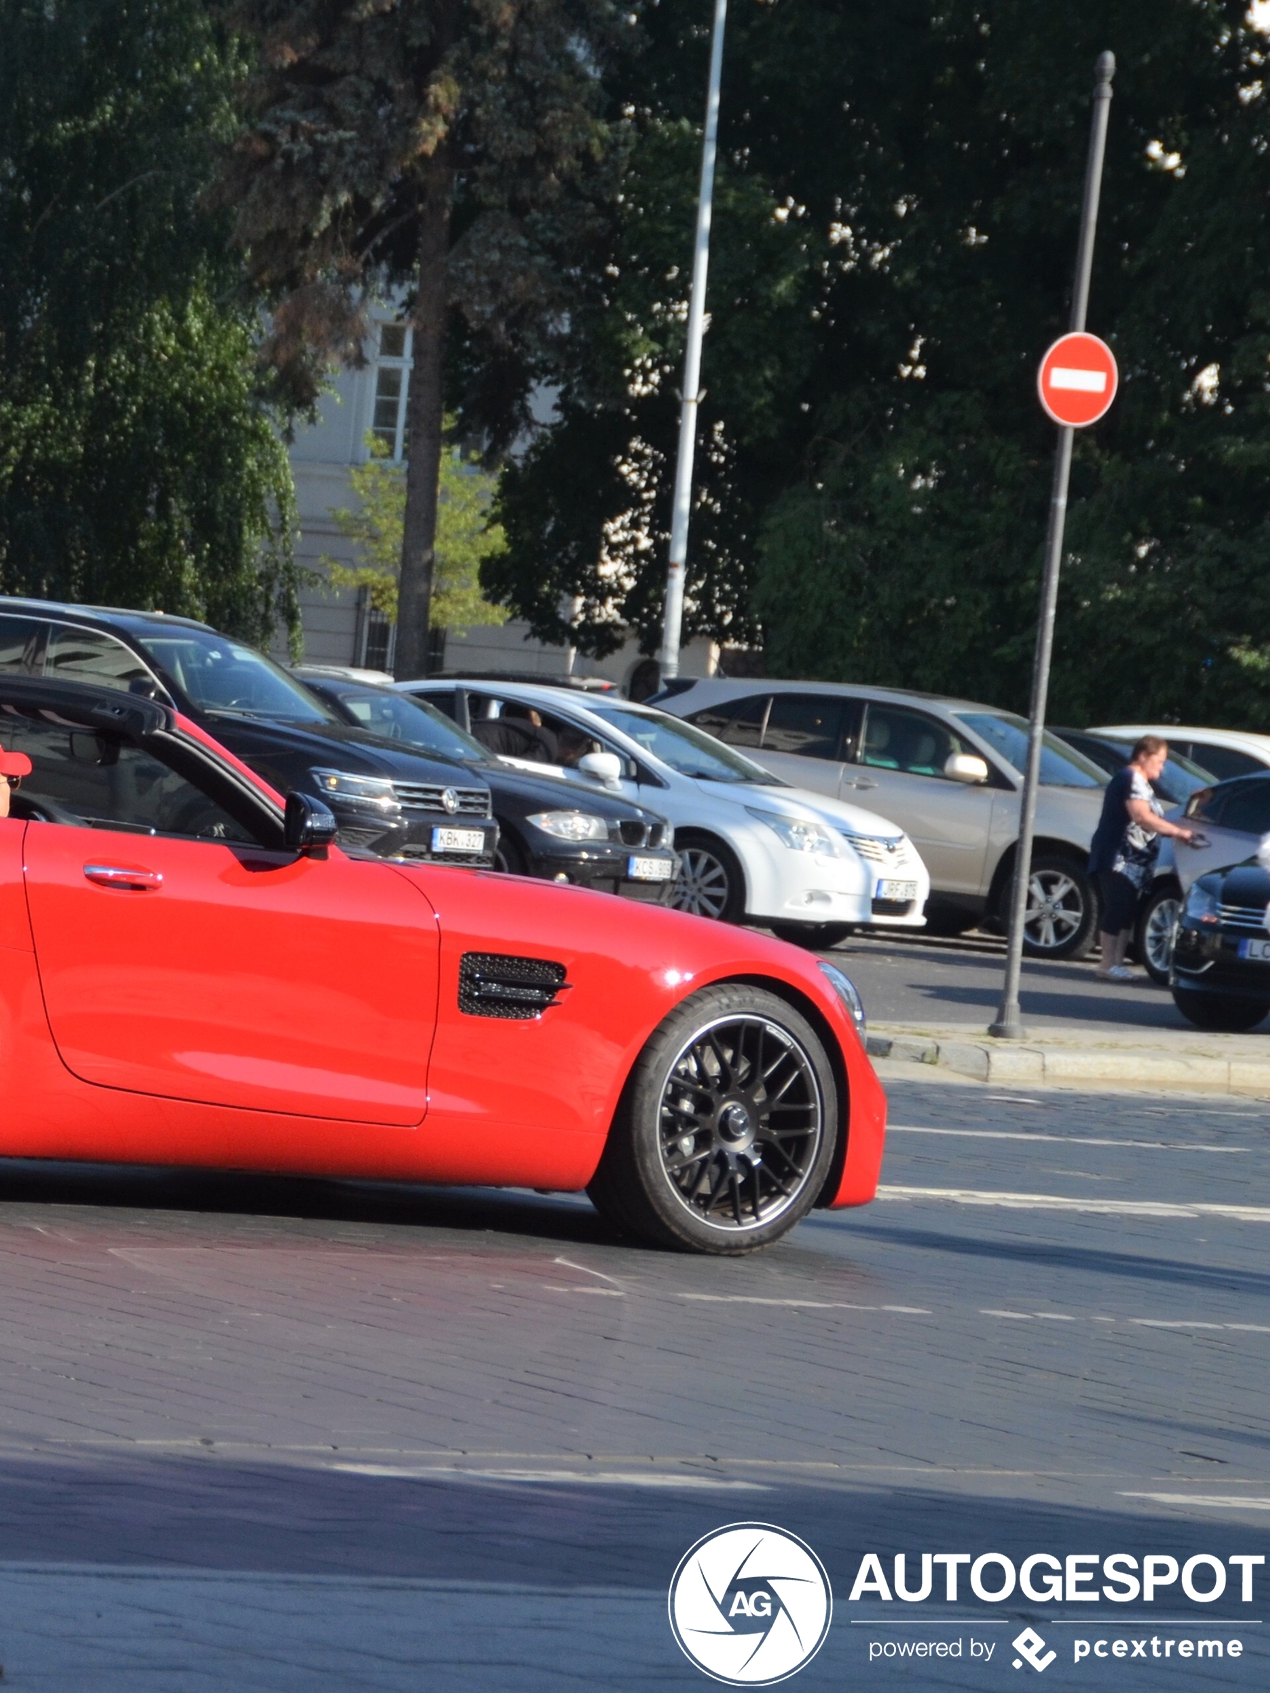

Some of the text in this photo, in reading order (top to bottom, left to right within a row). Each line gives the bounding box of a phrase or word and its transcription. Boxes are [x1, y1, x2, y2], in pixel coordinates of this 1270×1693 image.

[439, 831, 483, 848] KBK 327
[634, 860, 654, 875] KCS
